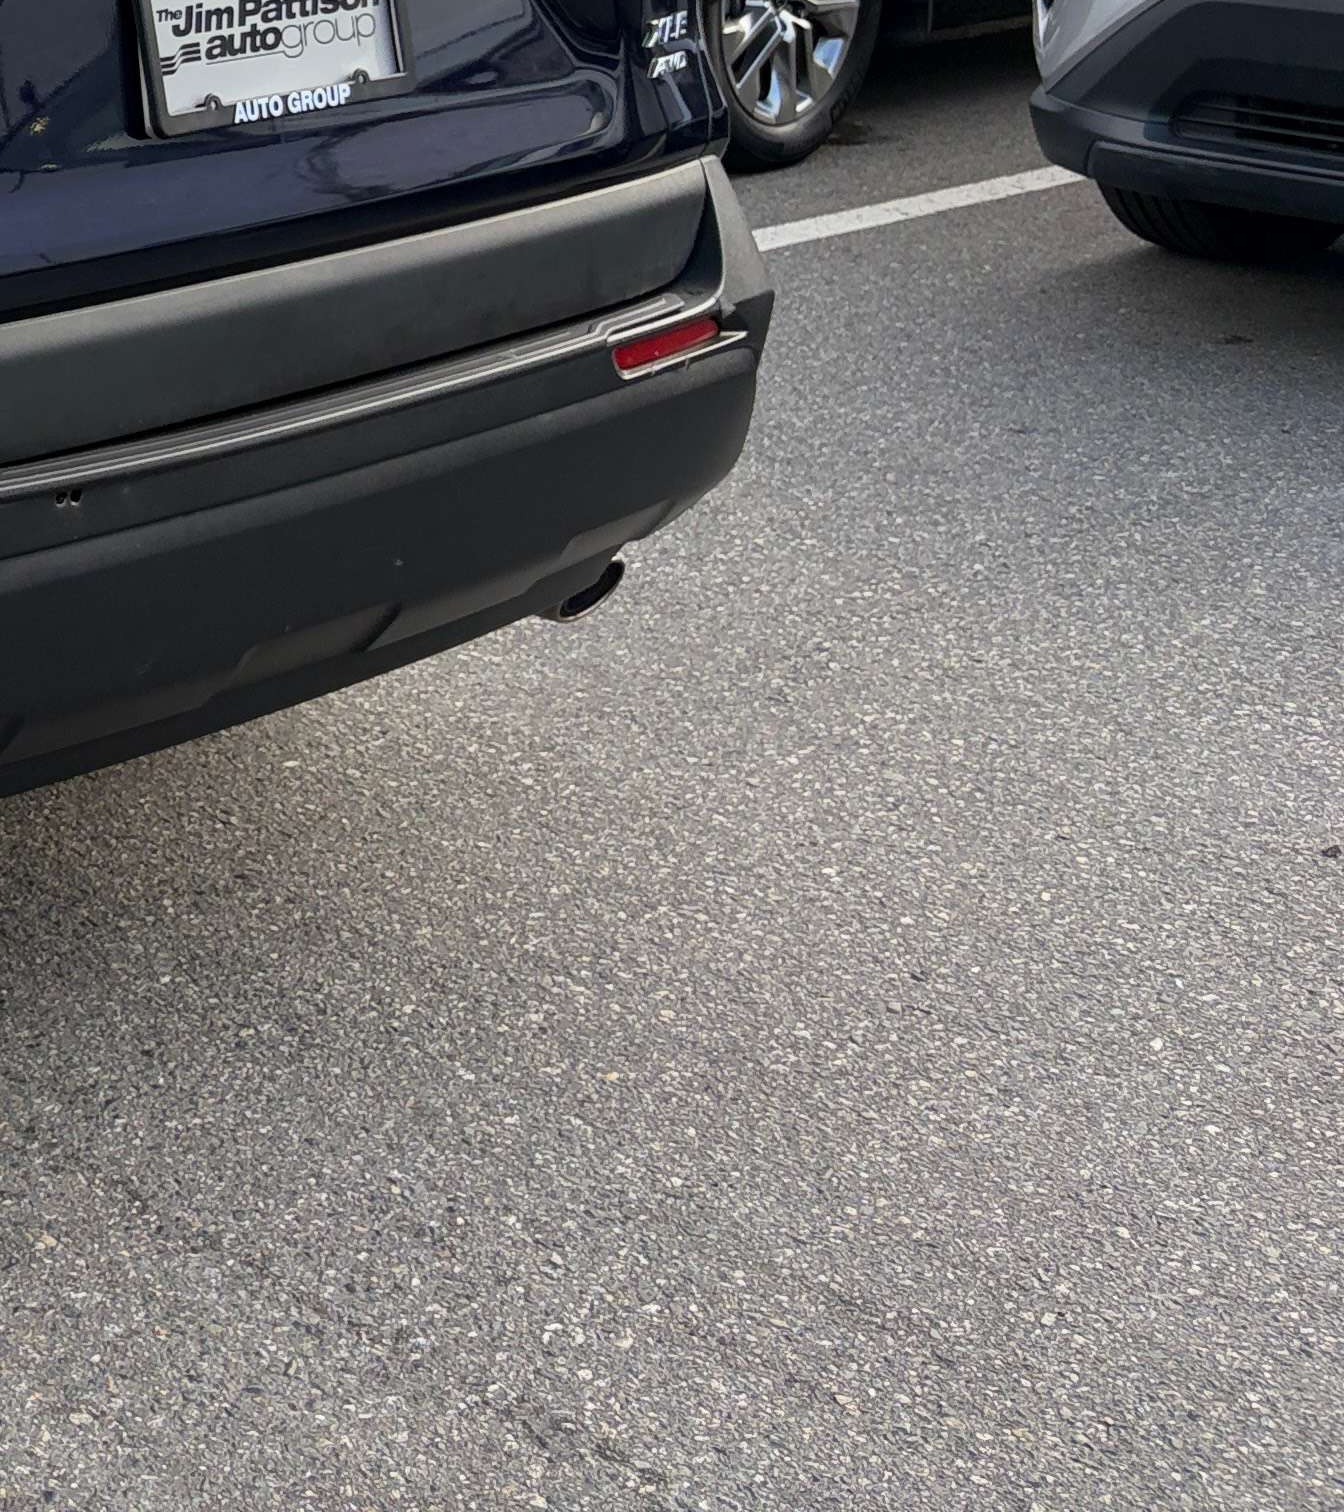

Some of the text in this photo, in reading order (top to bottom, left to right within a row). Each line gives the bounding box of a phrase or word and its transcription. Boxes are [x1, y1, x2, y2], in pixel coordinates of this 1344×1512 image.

[156, 7, 183, 23] The
[172, 3, 235, 37] Jim
[234, 84, 352, 124] AUTO GROUP
